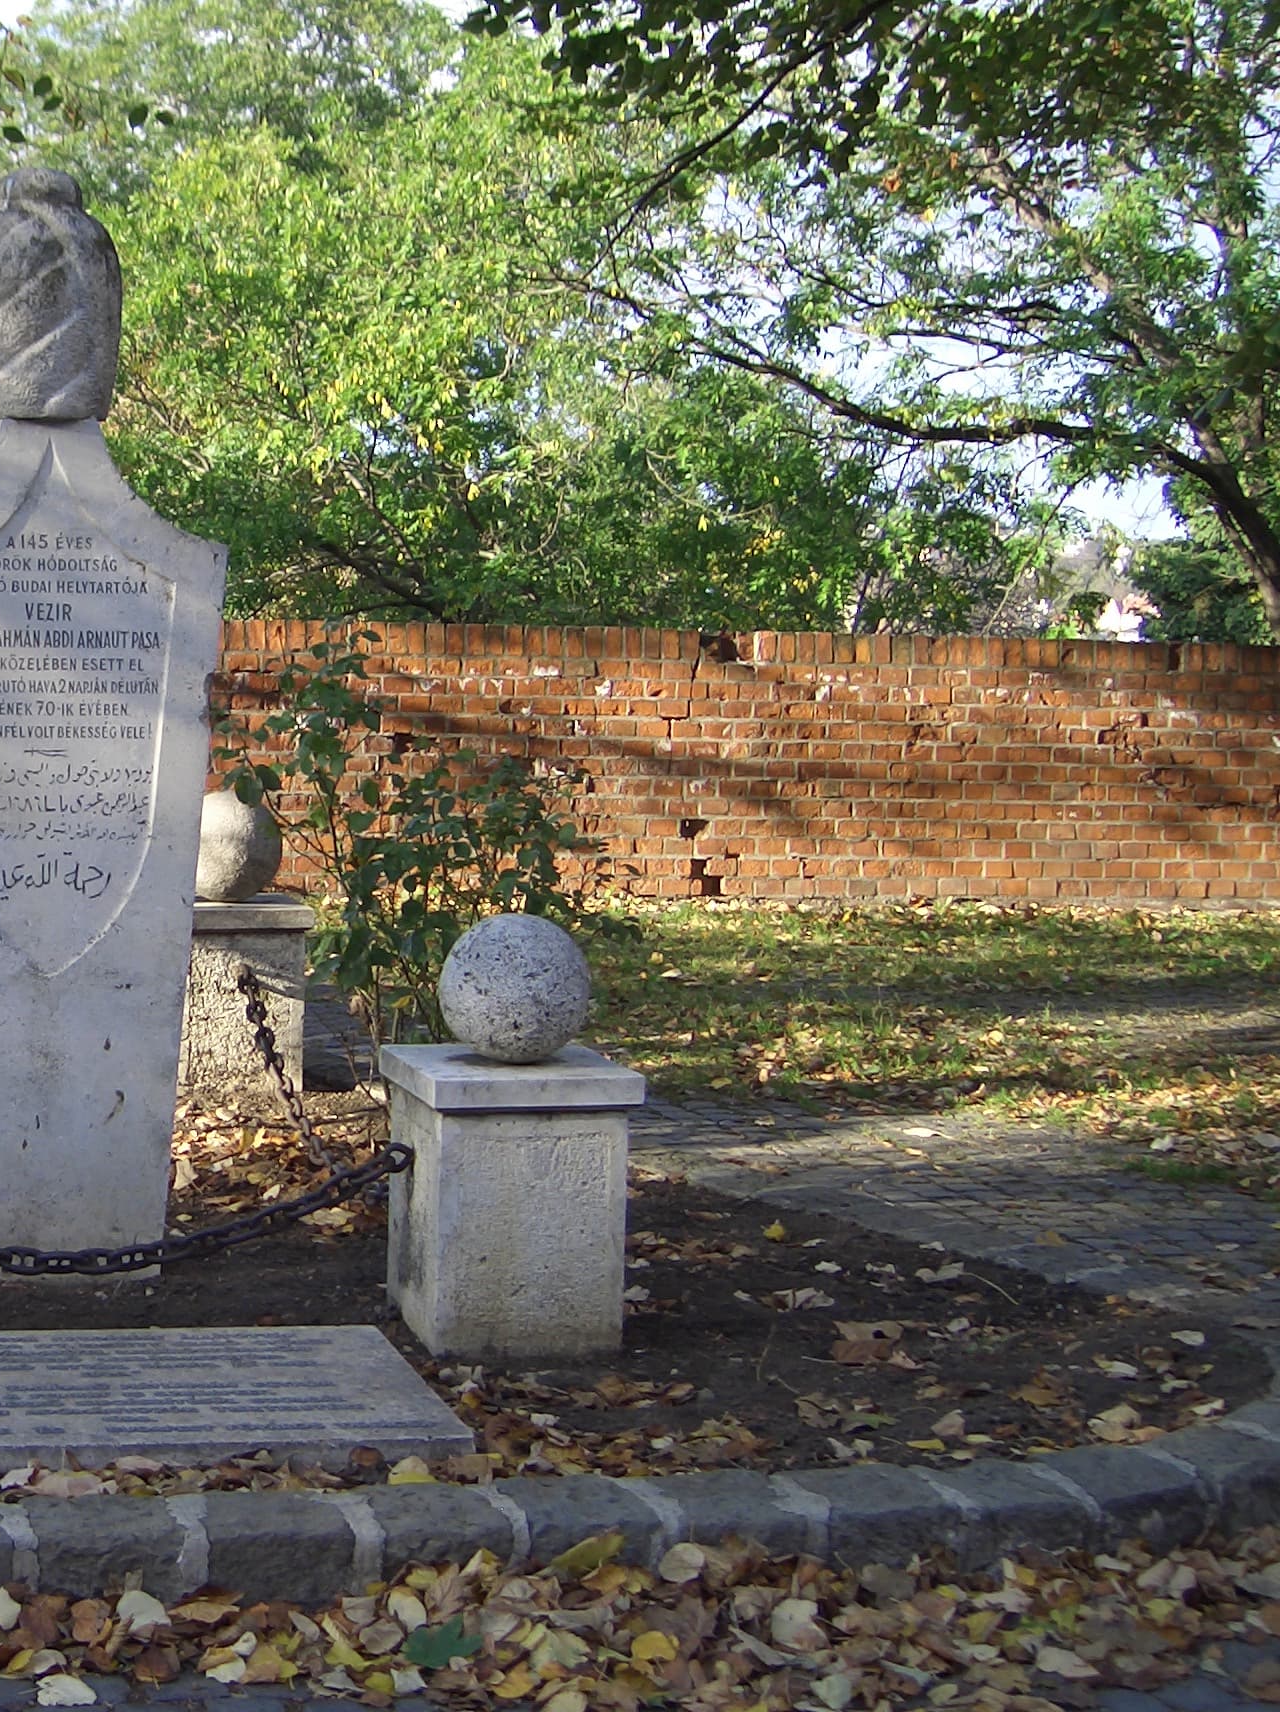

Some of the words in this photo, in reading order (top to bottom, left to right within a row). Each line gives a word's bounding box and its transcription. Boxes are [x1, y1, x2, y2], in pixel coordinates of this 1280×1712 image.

[6, 536, 16, 549] A
[20, 533, 48, 550] 145
[55, 532, 93, 551] ÉVES
[37, 553, 117, 572] HÓDOLTSÁG
[11, 580, 51, 593] BUDAI
[56, 575, 148, 594] HELYTARTÓJA
[25, 602, 72, 622] VEZIR
[43, 630, 74, 649] ABDI
[76, 630, 129, 649] ARNAUT
[131, 630, 160, 649] PASA
[0, 654, 77, 672] KÖZELÉBEN
[81, 658, 124, 671] ESETT
[128, 658, 144, 672] EL
[28, 679, 57, 694] HAVA
[58, 678, 66, 694] 2
[68, 677, 107, 694] NAPJÁN
[110, 677, 159, 694] DÉLUTÁN
[35, 700, 74, 717] 70-IK
[79, 699, 128, 717] ÉVÉBEN
[27, 725, 55, 738] VOLT
[57, 721, 117, 739] BÉKESSÉG
